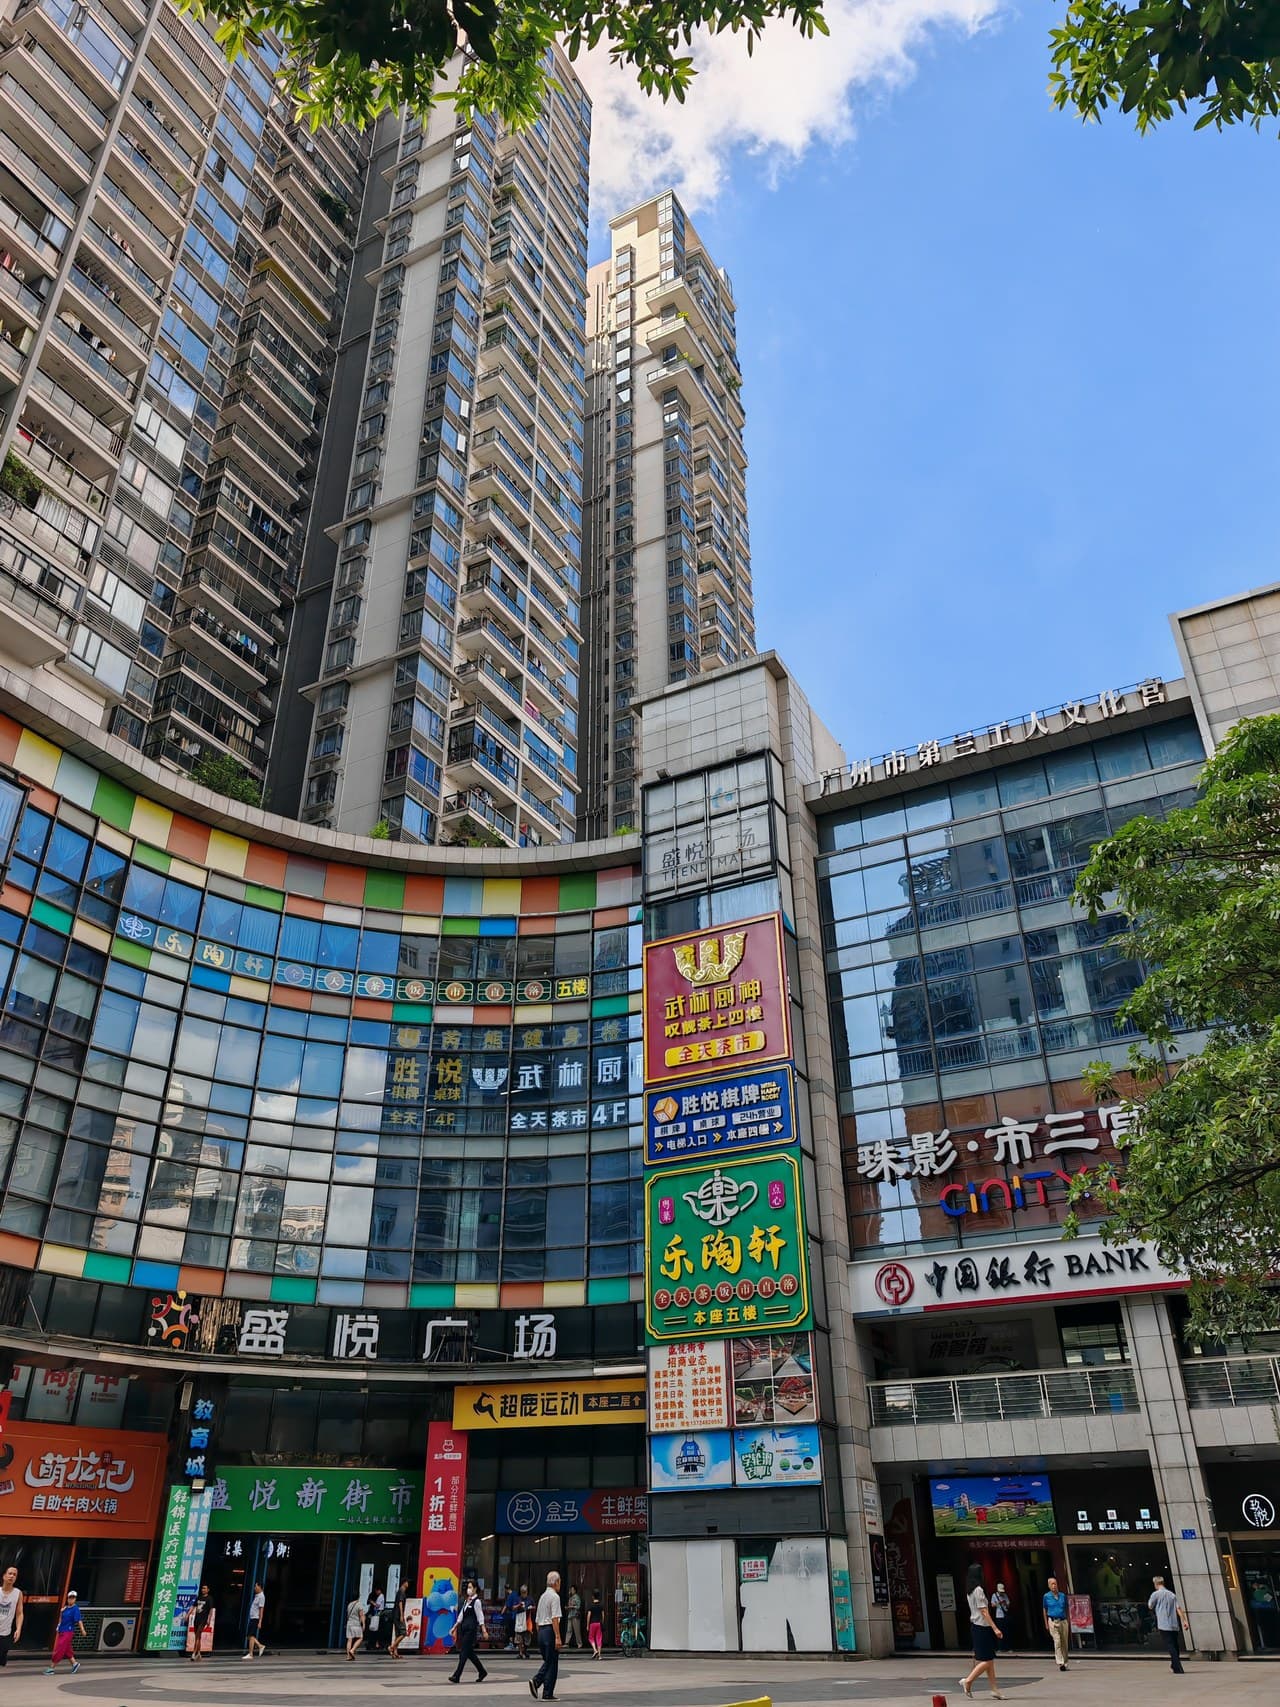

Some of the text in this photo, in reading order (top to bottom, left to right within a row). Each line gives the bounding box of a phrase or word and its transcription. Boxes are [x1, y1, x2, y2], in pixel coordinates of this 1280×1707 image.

[819, 679, 1165, 796] 广州市第三工人文化宫
[663, 827, 755, 869] 盛悦广场
[557, 978, 587, 997] 五楼
[664, 979, 762, 1020] 武林厨神
[664, 1006, 763, 1037] 叹靓茶上四楼
[679, 1034, 751, 1062] 全天茶市
[393, 1056, 463, 1085] 胜悦
[433, 1086, 461, 1101] 桌球
[682, 1084, 761, 1116] 胜悦棋牌
[390, 1111, 416, 1125] 全天
[435, 1113, 456, 1126] 4F
[660, 1124, 681, 1136] 棋牌
[740, 1108, 776, 1122] 24h营业
[666, 1123, 770, 1151] 电梯入口 本座四楼
[771, 1184, 783, 1207] 点心
[661, 1199, 672, 1222] 粤菜
[660, 1224, 787, 1281] 乐陶轩
[1067, 1246, 1150, 1278] BANK
[657, 1277, 796, 1306] 全天茶饭市直落
[693, 1304, 758, 1327] 本座五楼
[239, 1309, 556, 1360] 盛悦广场
[667, 1355, 707, 1368] 招商业态
[499, 1391, 631, 1418] 超鹿运动 本座二层
[185, 1399, 214, 1477] 教育城
[25, 1447, 134, 1493] 萌龙记
[32, 1494, 118, 1514] 自助牛肉火锅
[210, 1477, 416, 1514] 盛悦新街市
[428, 1476, 445, 1531] 1折起
[545, 1500, 579, 1522] 盒马
